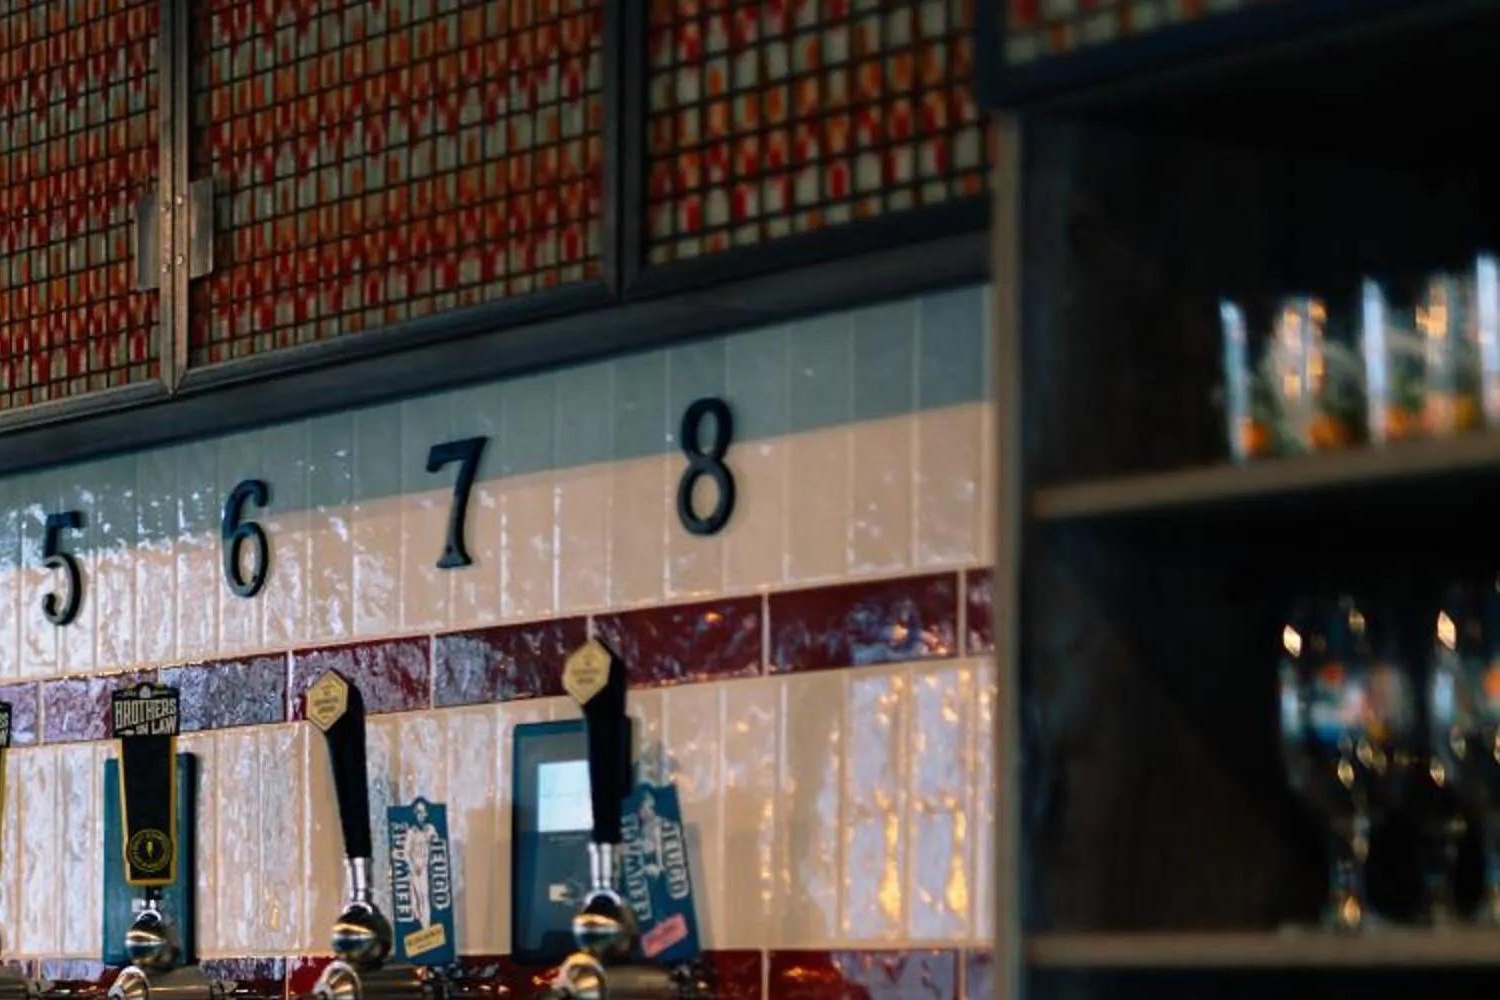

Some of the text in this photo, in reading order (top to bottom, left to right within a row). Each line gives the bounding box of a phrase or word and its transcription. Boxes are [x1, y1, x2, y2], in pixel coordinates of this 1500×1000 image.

[425, 435, 489, 569] 7
[676, 397, 736, 536] 8
[40, 511, 86, 626] 5
[222, 479, 269, 597] 6
[115, 698, 177, 729] BROTHERS
[152, 716, 177, 735] LAW
